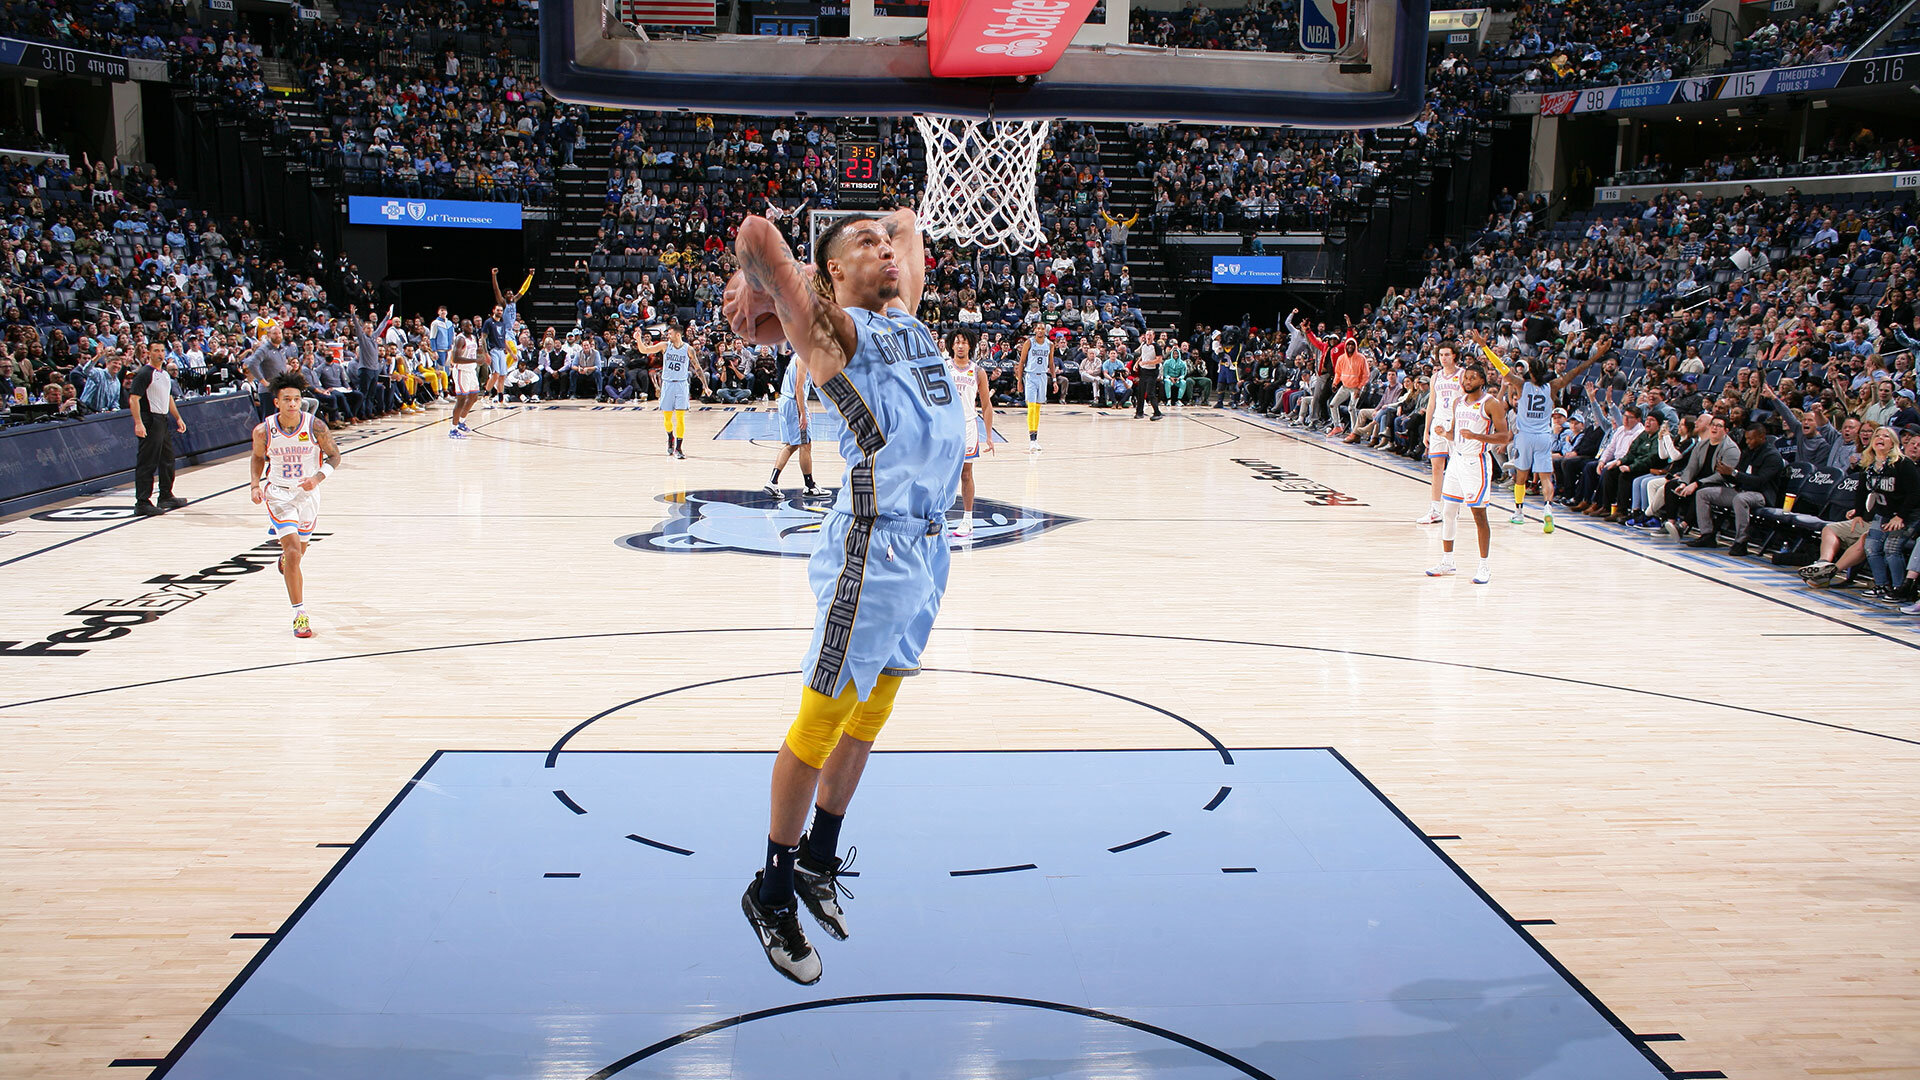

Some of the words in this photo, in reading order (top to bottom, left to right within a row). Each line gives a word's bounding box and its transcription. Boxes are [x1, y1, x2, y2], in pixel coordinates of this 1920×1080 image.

[1776, 1, 1794, 10] 116A
[304, 10, 316, 18] 102
[1307, 25, 1330, 44] NBA
[41, 48, 76, 73] 3:16
[87, 59, 105, 74] 4TH
[107, 62, 125, 76] QTR
[1778, 68, 1819, 82] TIMEOUTS:
[1820, 67, 1826, 77] 4
[1863, 57, 1904, 85] 3:16
[1620, 87, 1655, 97] TIMEOUTS:
[1655, 85, 1660, 95] 2
[1734, 75, 1755, 97] 115
[1776, 82, 1802, 93] FOULS:
[1803, 81, 1809, 90] 3
[1586, 90, 1604, 111] 98
[1619, 98, 1641, 108] FOULS:
[1641, 98, 1647, 107] 3
[852, 146, 876, 159] 3:15
[846, 158, 873, 179] 23
[1901, 176, 1917, 186] 116
[1605, 190, 1617, 200] 116
[426, 214, 438, 223] of
[440, 213, 493, 224] Tennessee
[871, 328, 940, 366] GRIZZLI
[668, 361, 681, 372] 46
[1037, 356, 1044, 365] 8
[910, 363, 953, 408] 15
[1527, 393, 1546, 412] 12
[282, 455, 302, 463] CITY
[282, 463, 303, 478] 23
